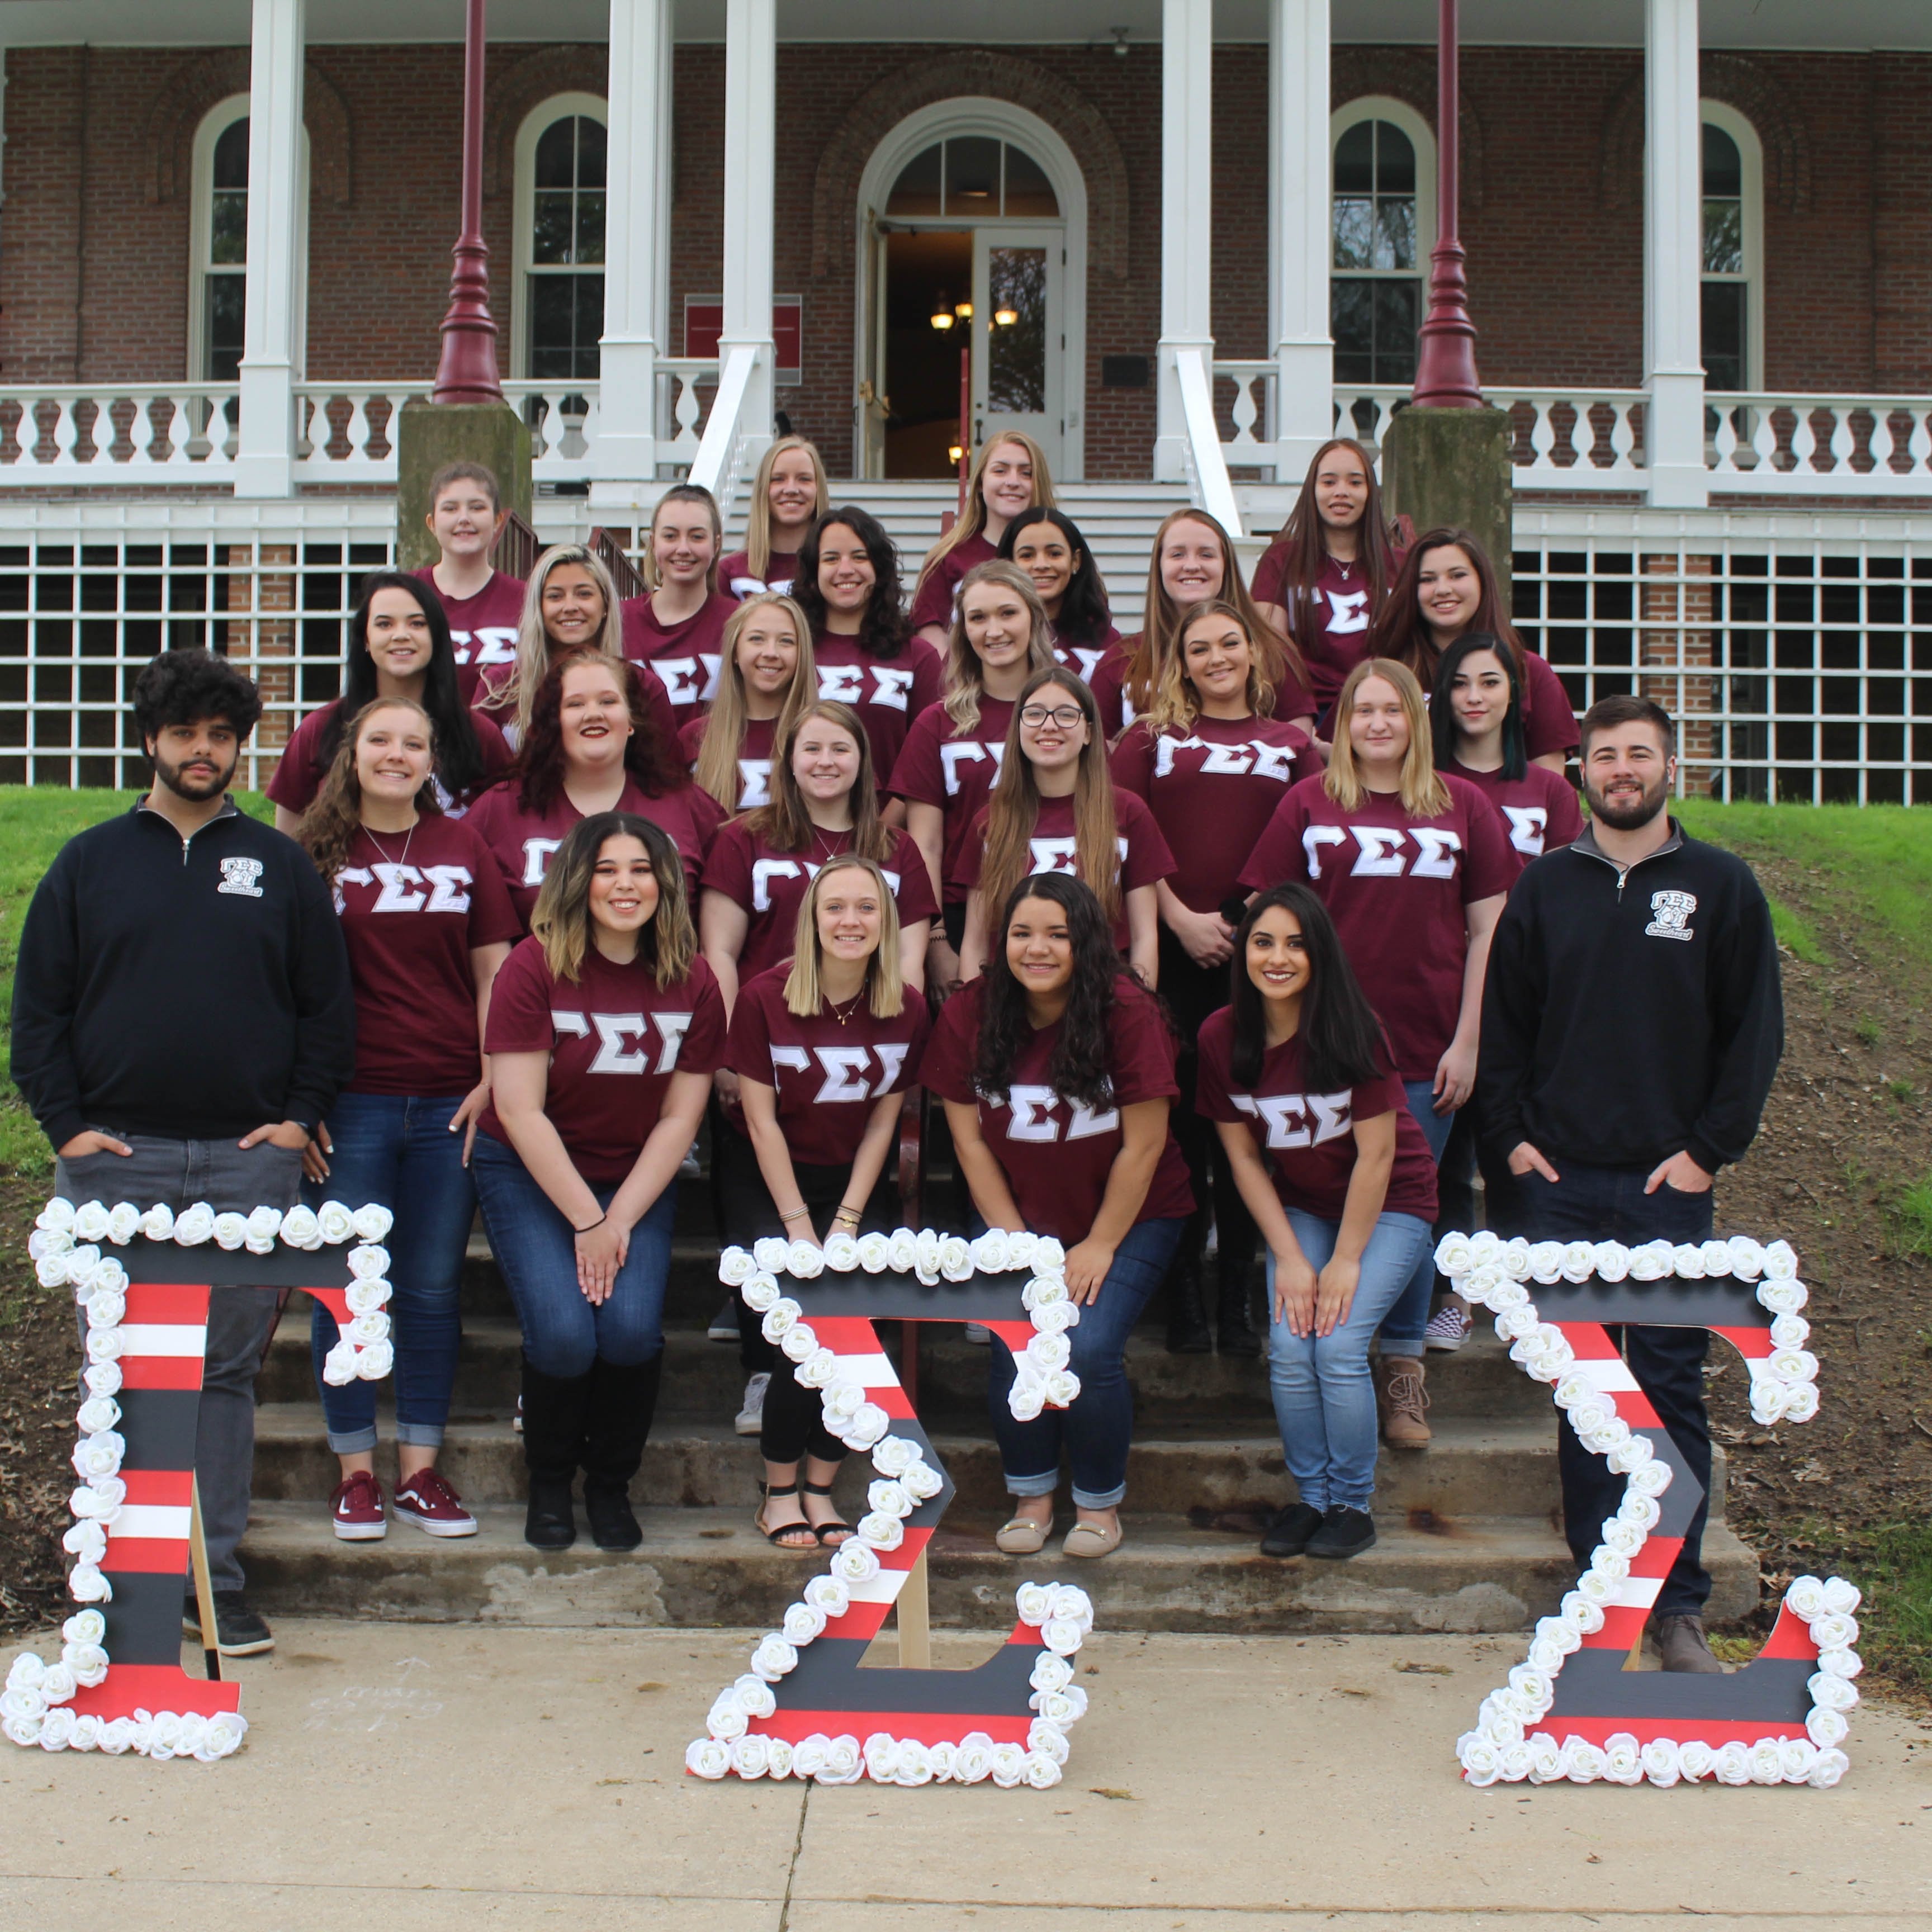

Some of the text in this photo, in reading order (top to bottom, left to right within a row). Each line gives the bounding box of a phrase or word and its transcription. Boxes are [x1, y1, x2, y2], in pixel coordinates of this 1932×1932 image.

[1154, 735, 1297, 782] ΓΣΣ
[222, 859, 262, 874] ΓΣΣ
[1302, 826, 1462, 879] ΓΣΣ
[333, 862, 473, 916] ΓΣΣ
[1653, 893, 1694, 912] ΓΣΣ
